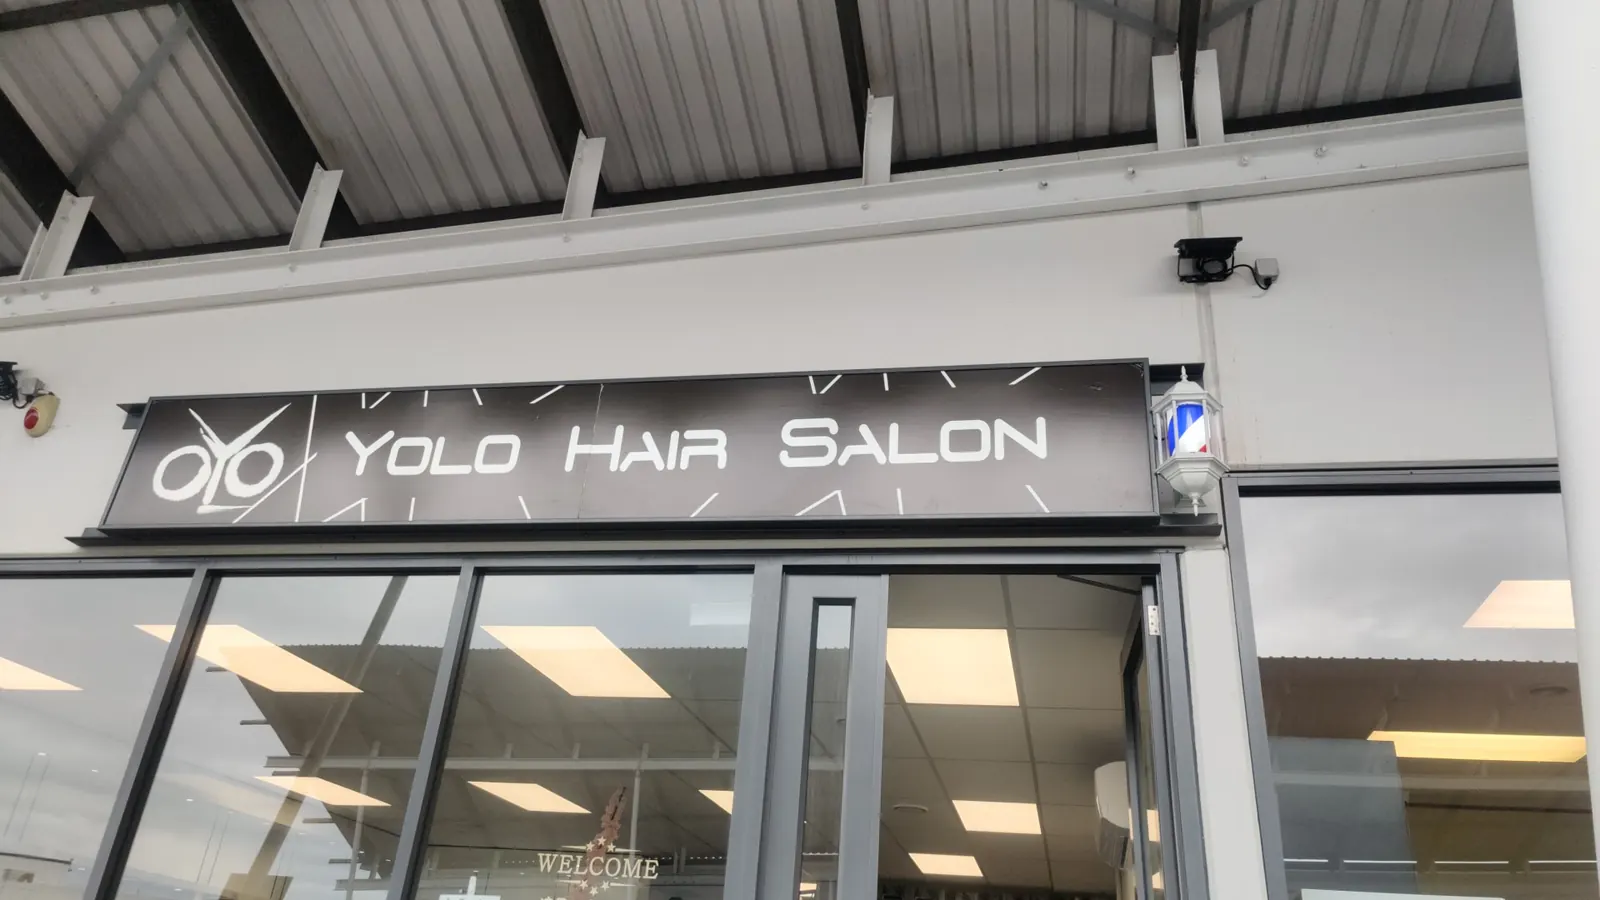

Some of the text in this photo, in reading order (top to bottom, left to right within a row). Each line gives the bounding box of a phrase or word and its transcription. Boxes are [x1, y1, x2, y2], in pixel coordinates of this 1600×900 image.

[345, 416, 1048, 476] YOLO HAIR SALON
[537, 852, 659, 880] WELCOME
